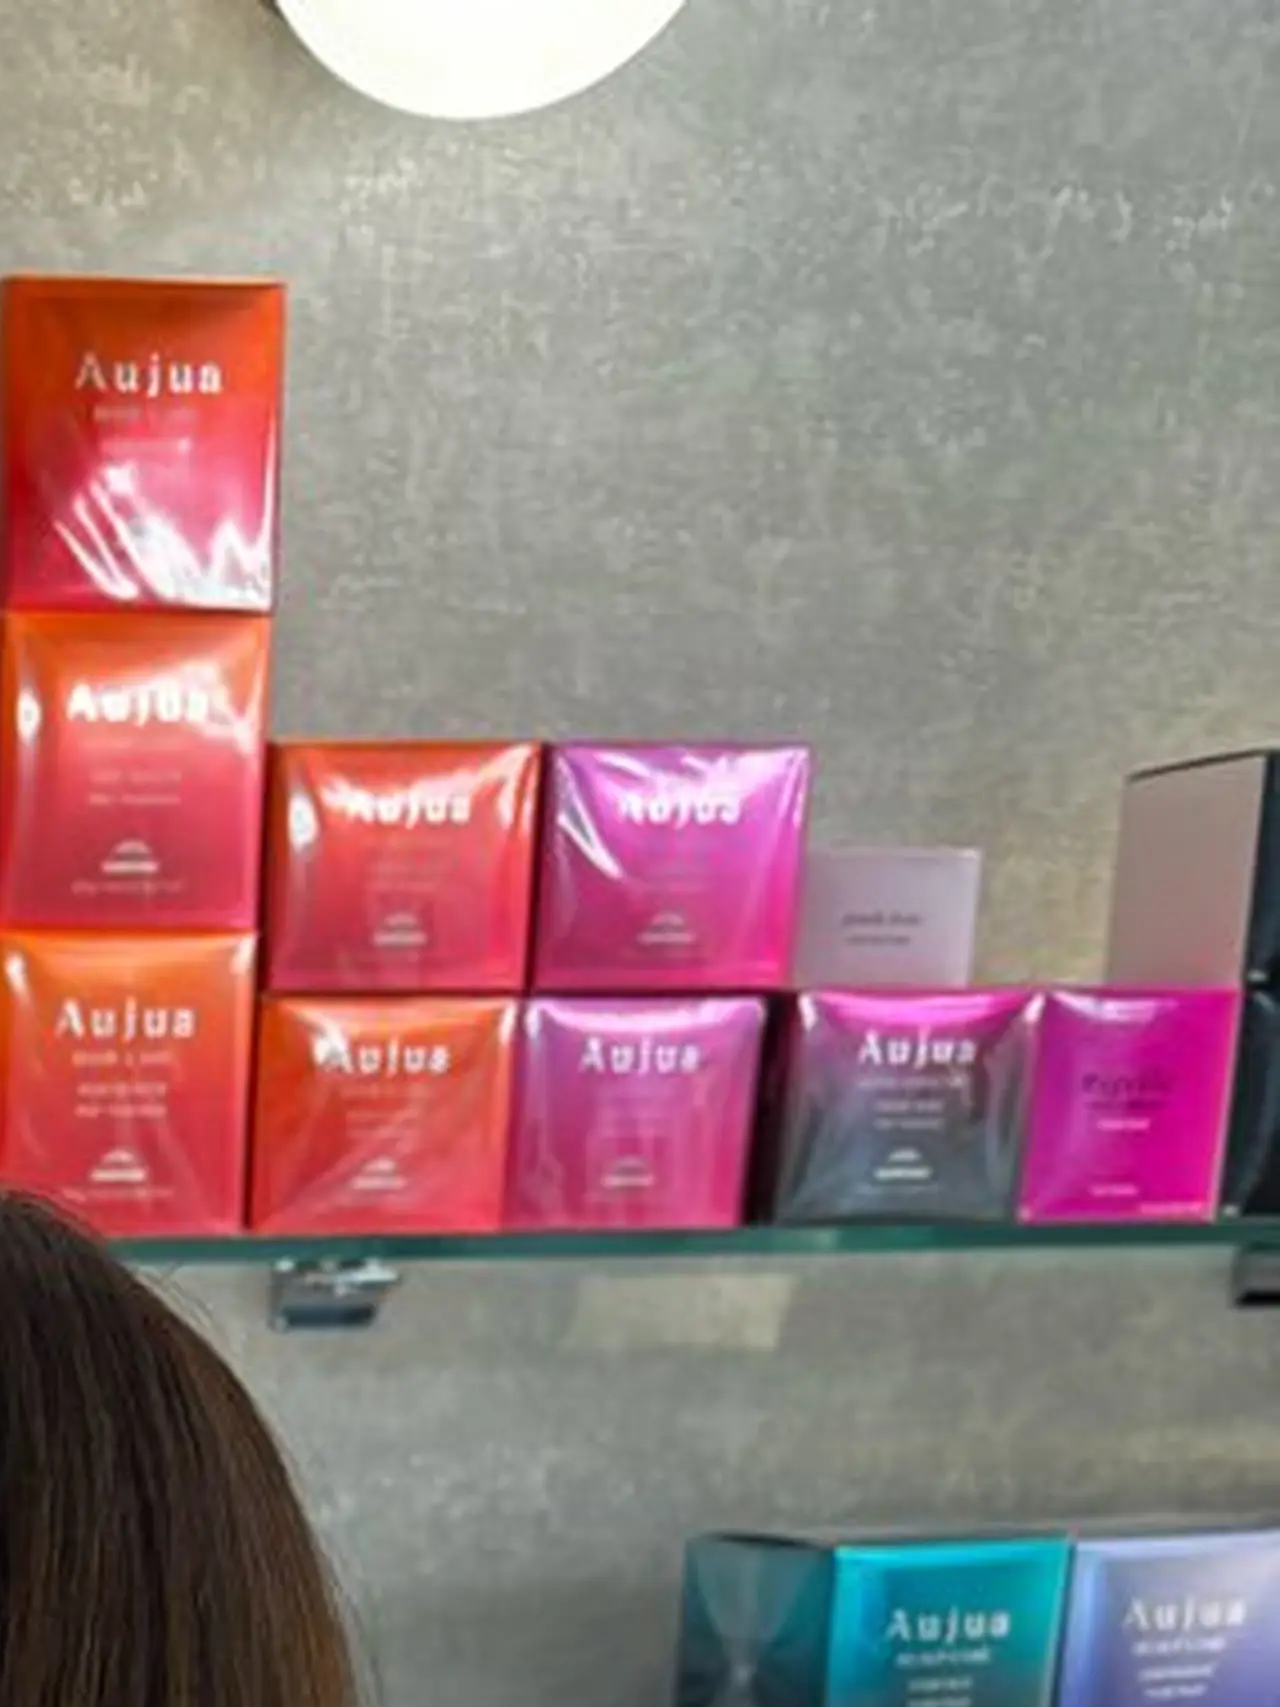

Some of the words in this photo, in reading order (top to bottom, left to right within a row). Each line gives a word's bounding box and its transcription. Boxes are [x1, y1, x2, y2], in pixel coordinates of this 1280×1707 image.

[75, 351, 222, 399] Aujua
[54, 996, 196, 1043] Aujua
[579, 1037, 701, 1076] Aujua
[858, 1027, 977, 1070] Aujua
[885, 1606, 1011, 1644] Aujua
[1123, 1595, 1246, 1633] Aujua
